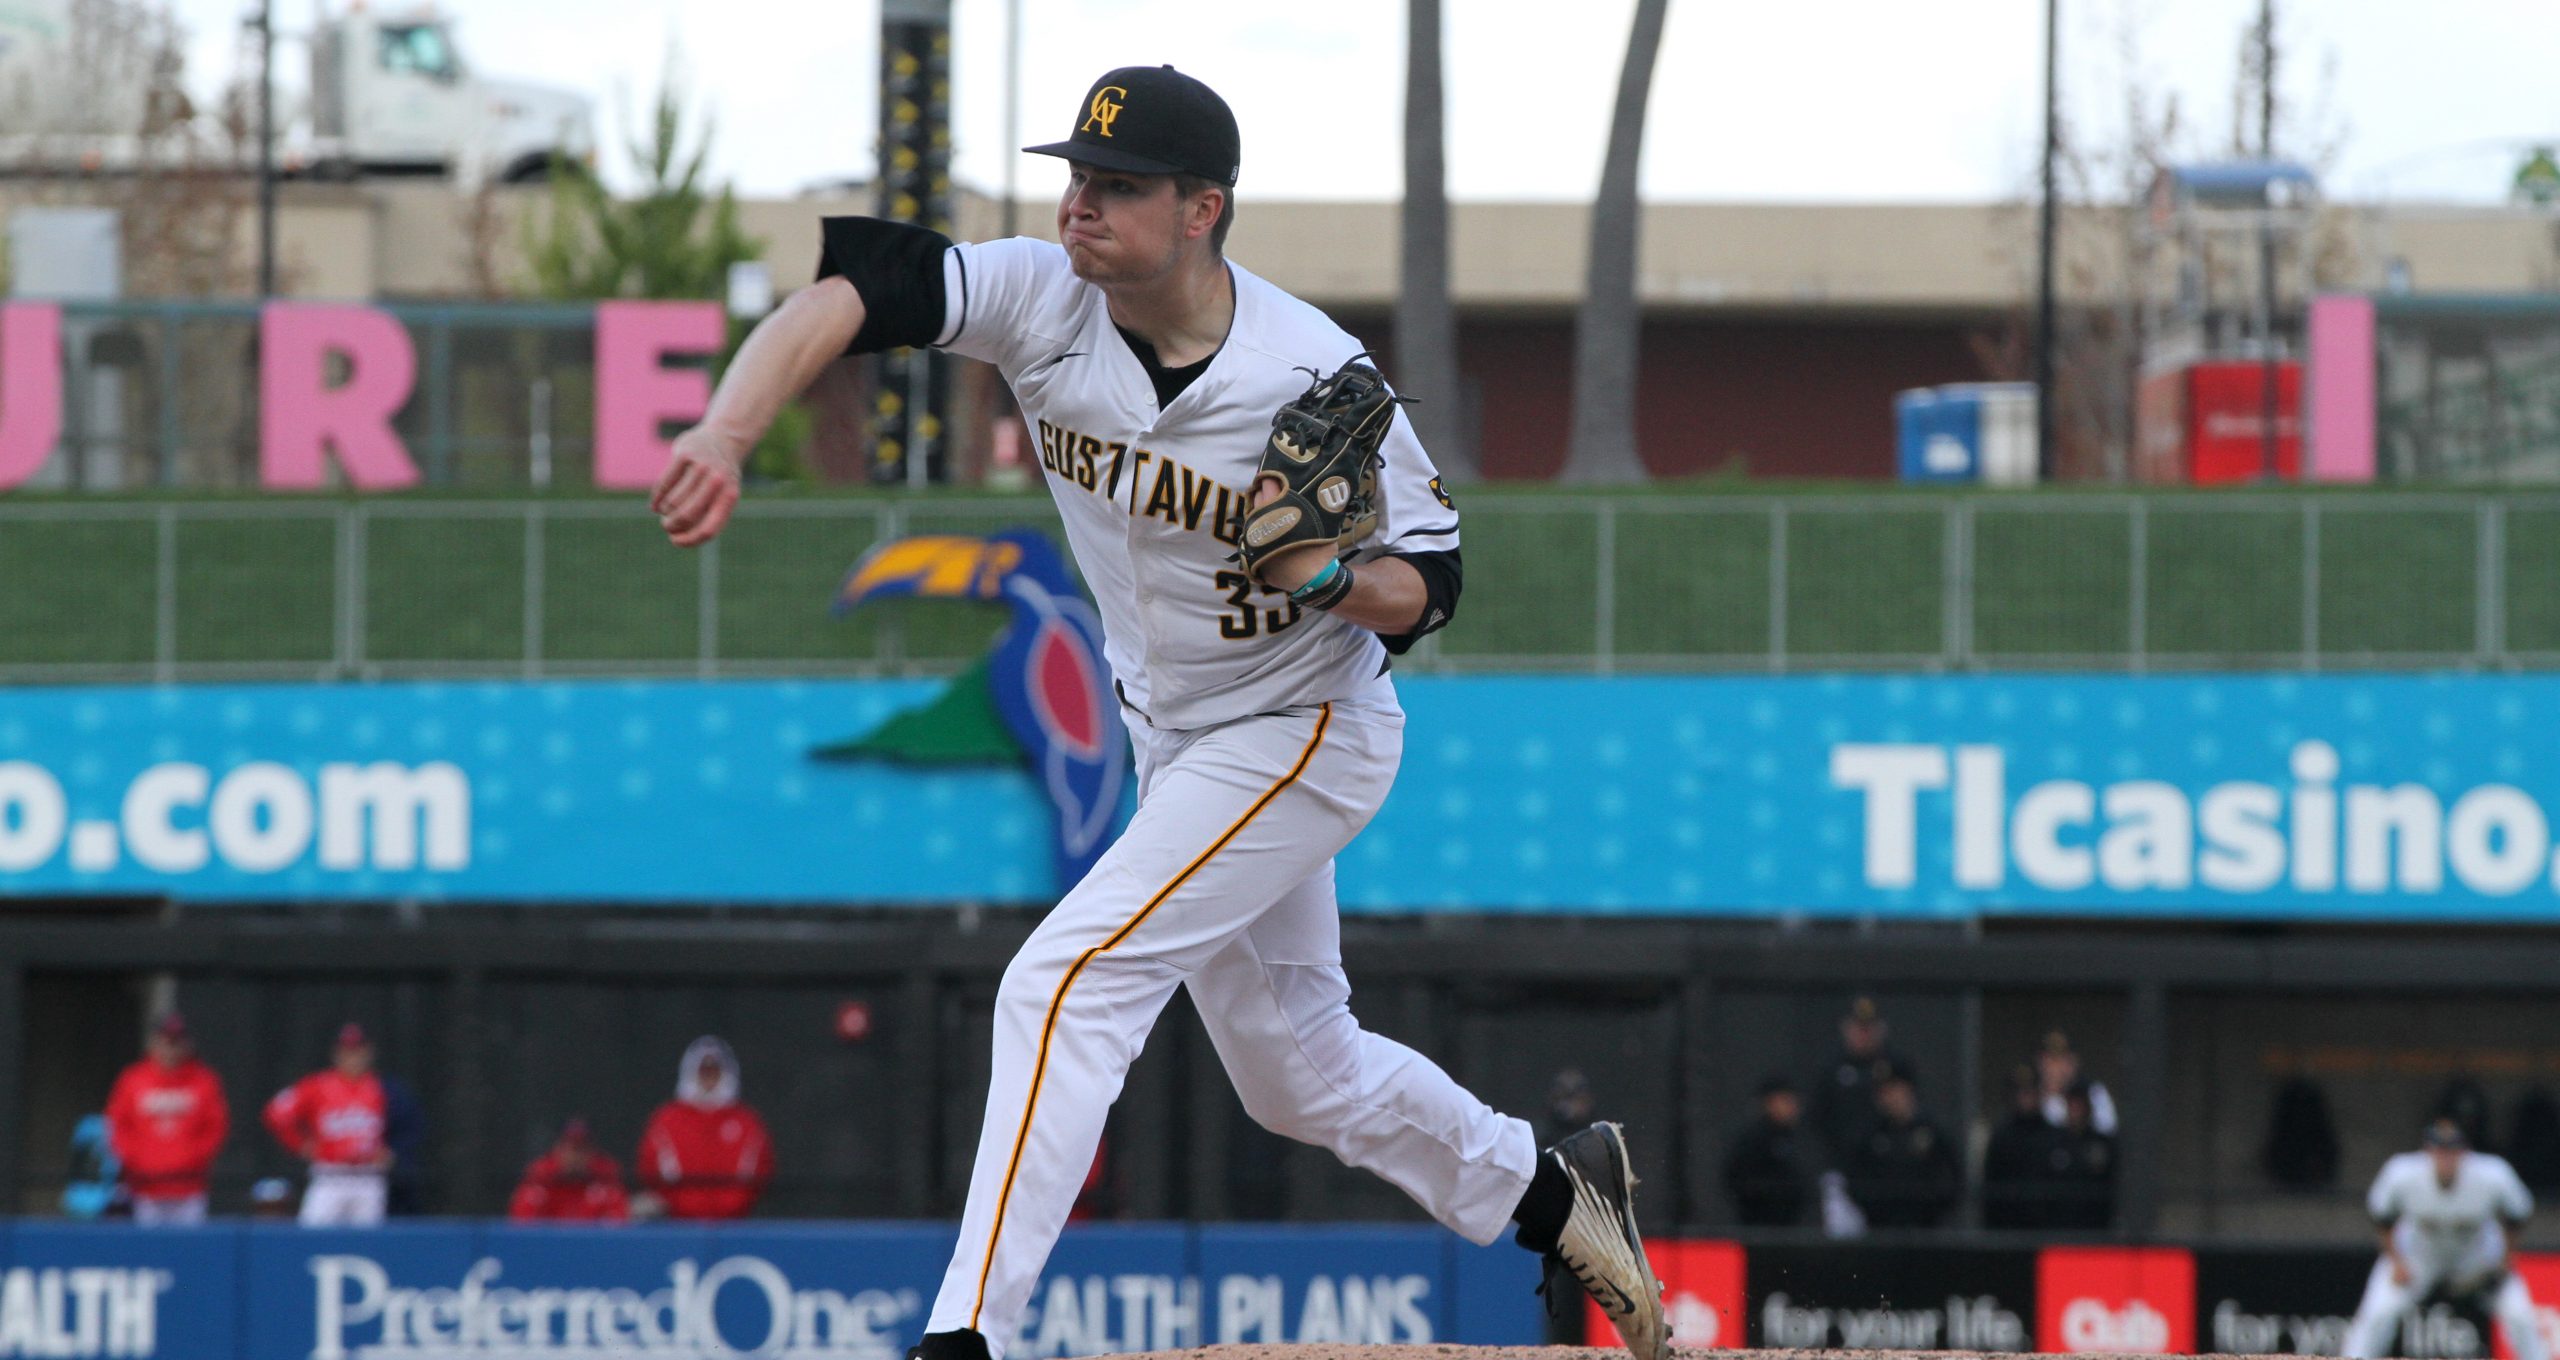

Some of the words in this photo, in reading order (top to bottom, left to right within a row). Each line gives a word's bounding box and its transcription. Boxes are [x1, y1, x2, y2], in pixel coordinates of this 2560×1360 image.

[0, 760, 471, 874] o.com
[1830, 739, 2560, 895] TIcasino
[308, 1254, 902, 1359] PreferredOne
[1217, 1274, 1434, 1344] PLANS
